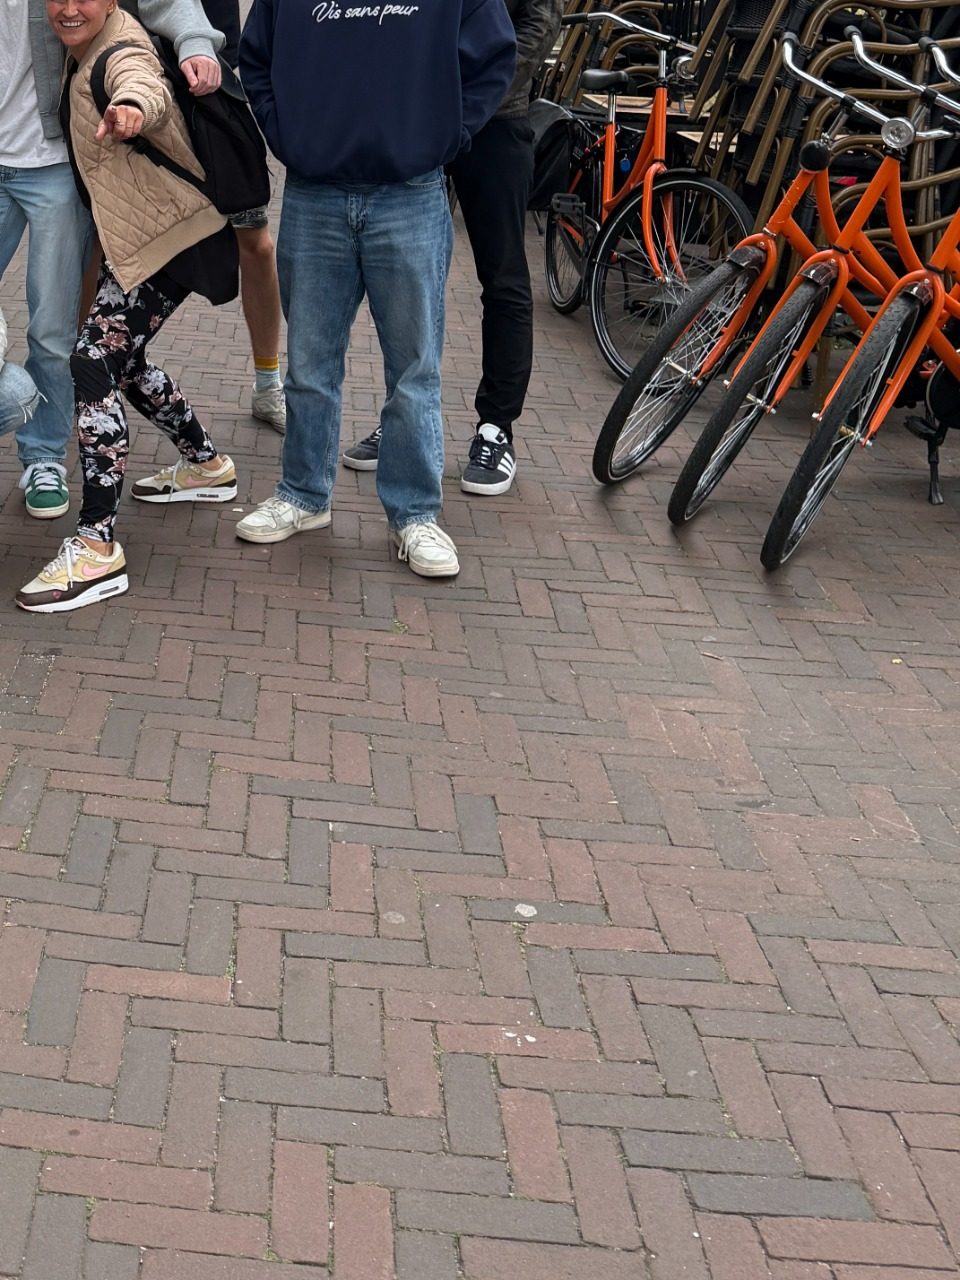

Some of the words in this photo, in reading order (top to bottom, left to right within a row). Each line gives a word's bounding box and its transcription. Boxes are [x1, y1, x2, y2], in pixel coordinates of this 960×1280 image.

[312, 0, 342, 23] Vis
[344, 5, 381, 19] sans
[378, 4, 419, 25] peur
